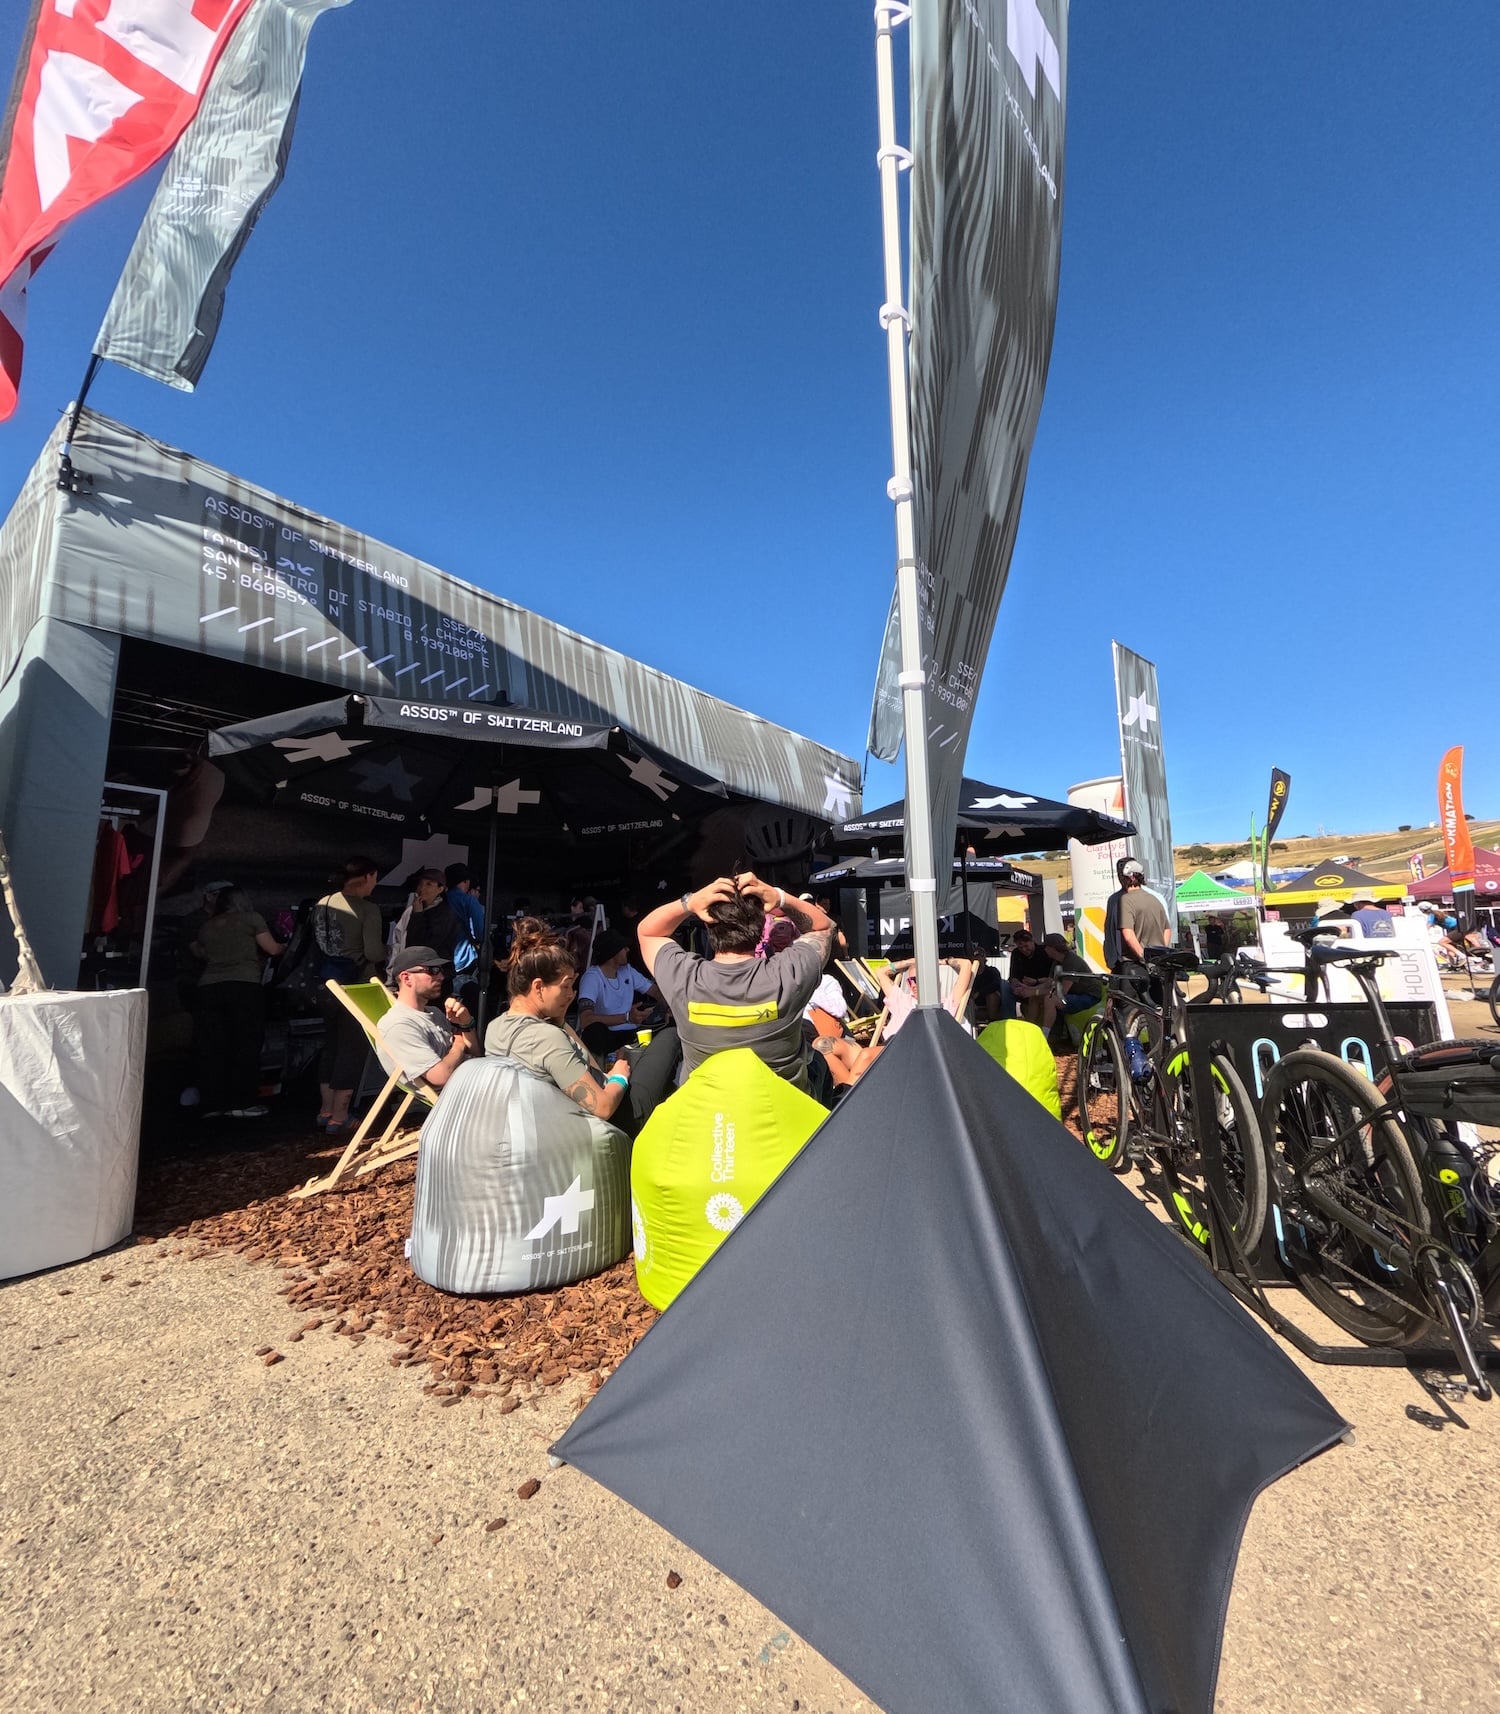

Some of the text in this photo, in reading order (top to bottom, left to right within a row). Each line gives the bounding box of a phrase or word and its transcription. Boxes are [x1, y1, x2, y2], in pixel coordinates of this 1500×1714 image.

[281, 527, 303, 543] OF
[308, 538, 409, 589] SWITZERLAND
[202, 546, 241, 569] SAN
[251, 562, 319, 596] PIETRO
[328, 589, 349, 606] DI
[358, 599, 412, 628] STABIO
[435, 627, 489, 655] CH-6854
[329, 604, 340, 618] N
[442, 617, 488, 643] SSE/76
[482, 657, 490, 669] E
[463, 711, 482, 724] OF
[487, 714, 583, 737] SWITZERLAND
[338, 800, 349, 811] OF
[352, 803, 405, 822] SWITZERLAND
[607, 823, 617, 832] OF
[618, 819, 664, 831] SWITZERLAND
[868, 821, 878, 829] OF
[879, 818, 904, 828] SWITZE
[710, 1112, 724, 1183] Collective
[722, 1121, 736, 1183] Thirteen
[546, 1250, 556, 1258] OF
[556, 1240, 593, 1256] SWITZERLAND
